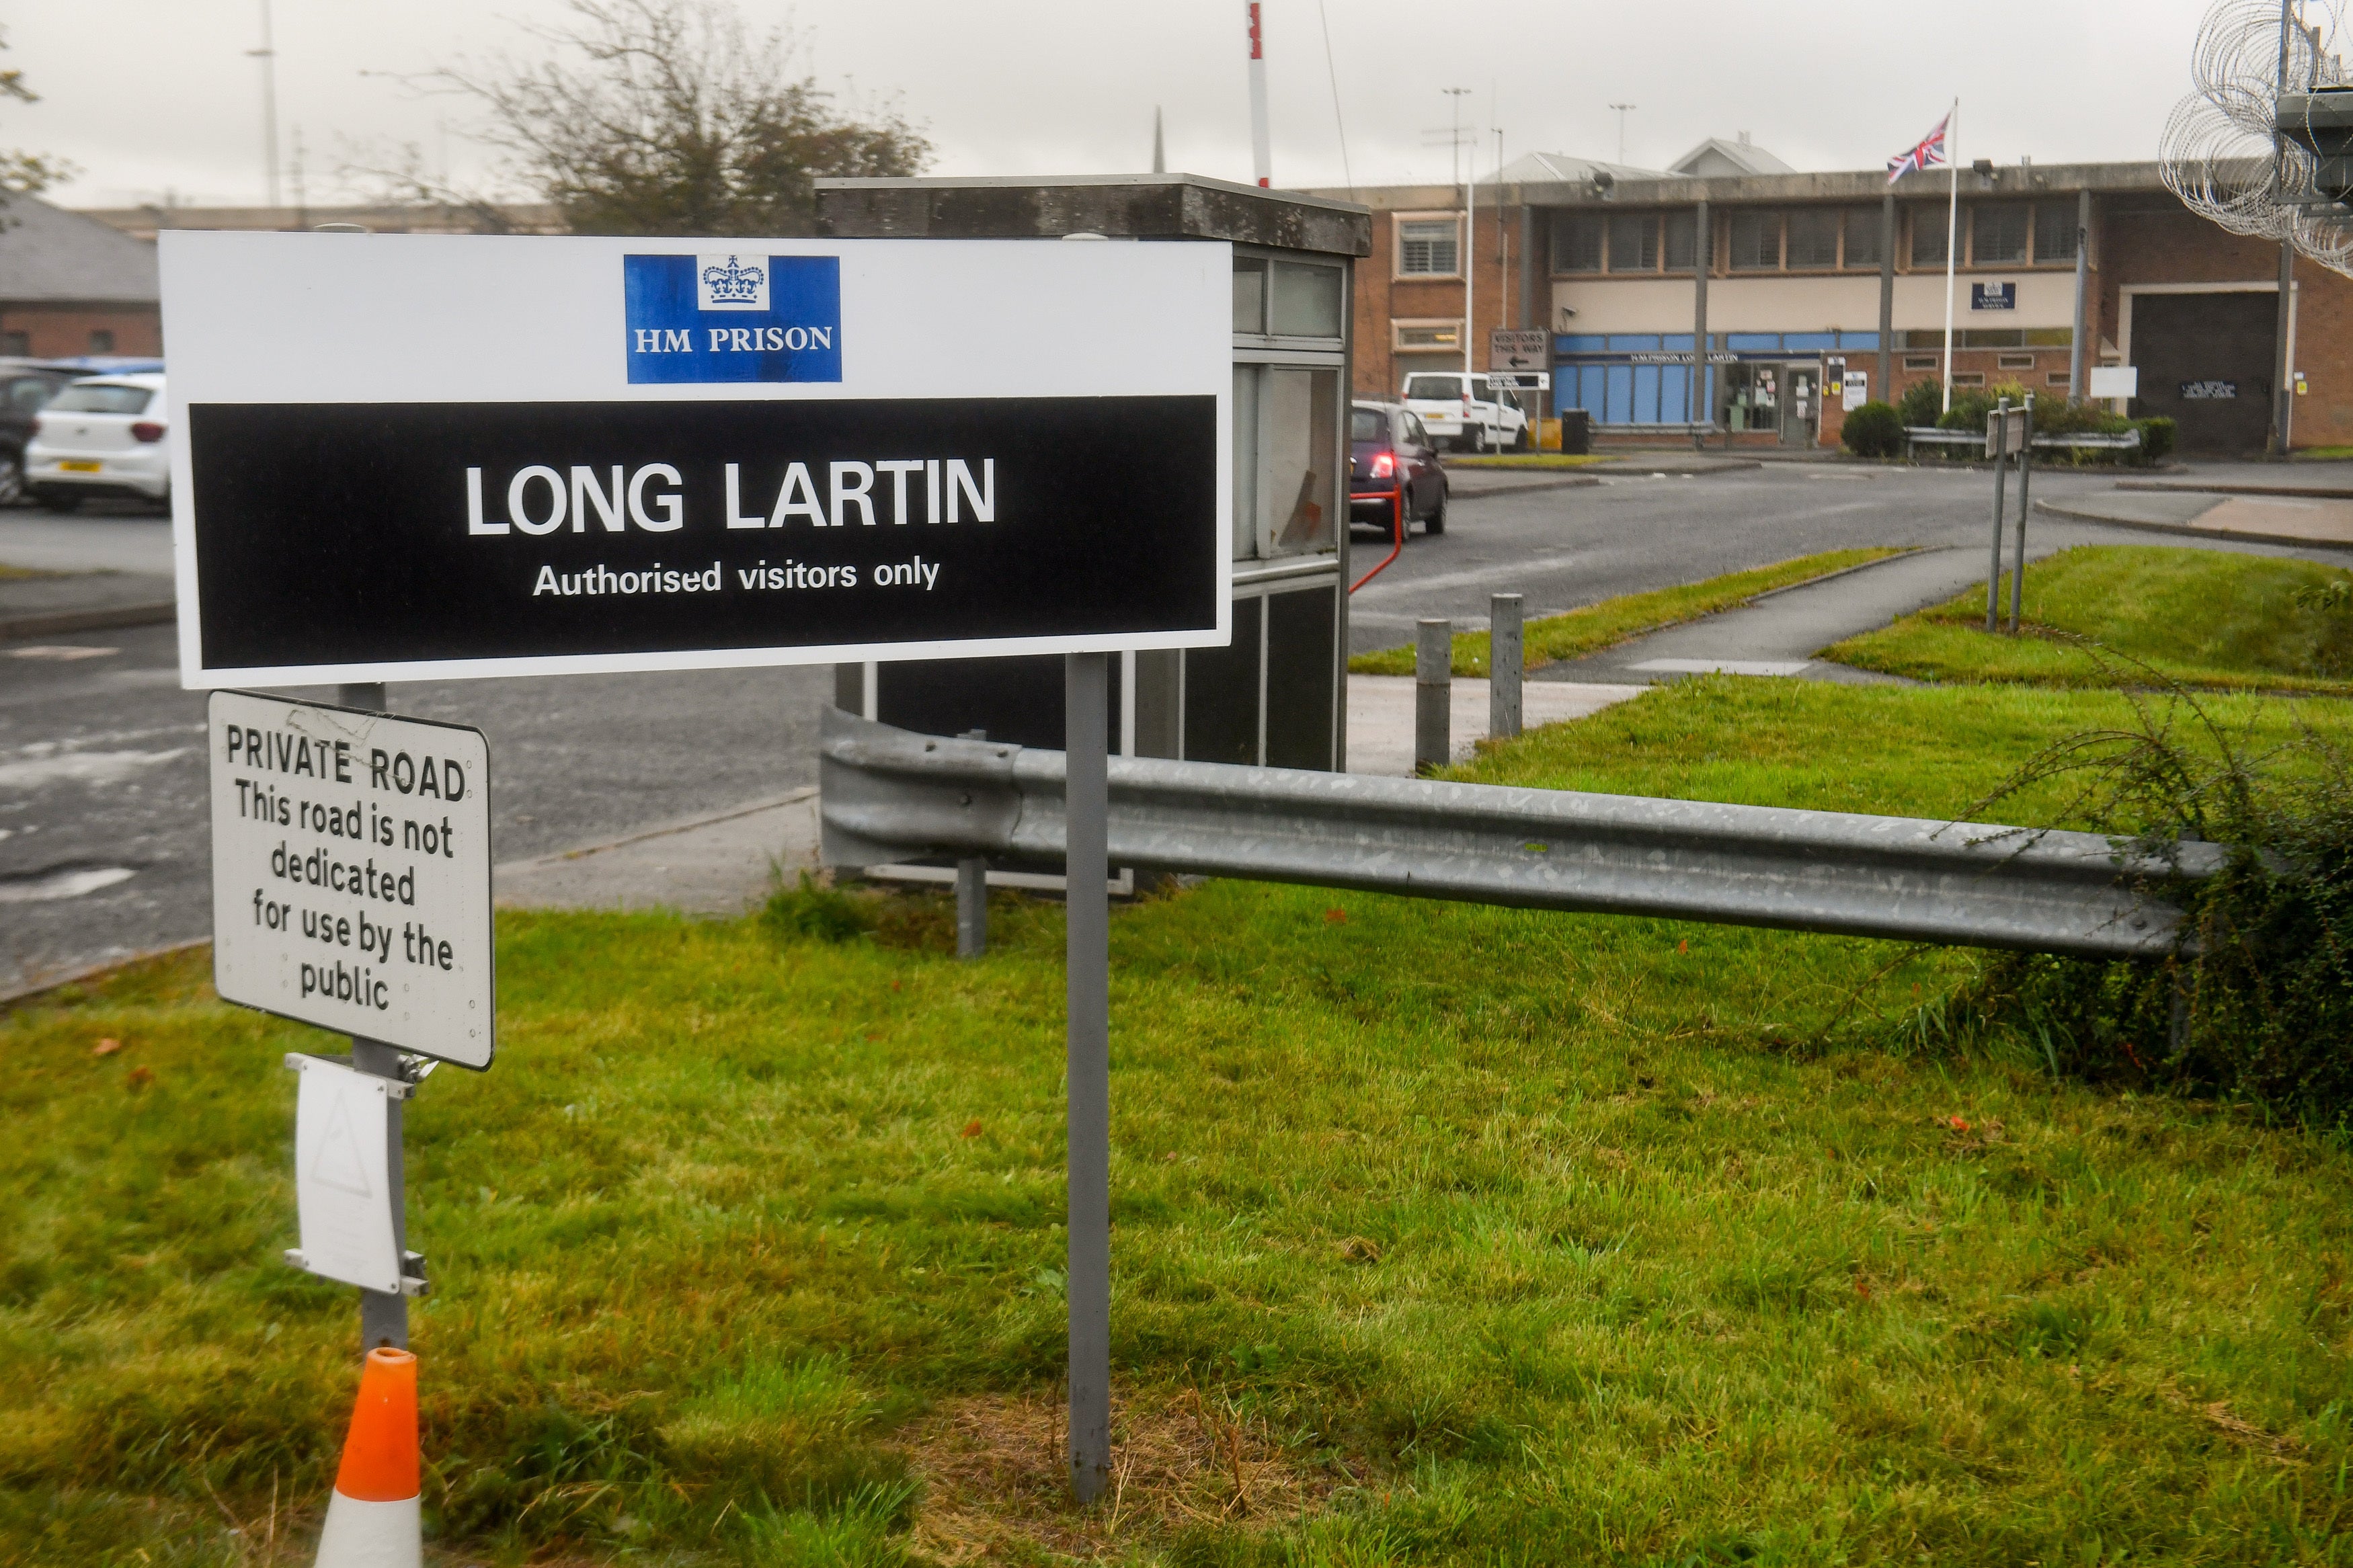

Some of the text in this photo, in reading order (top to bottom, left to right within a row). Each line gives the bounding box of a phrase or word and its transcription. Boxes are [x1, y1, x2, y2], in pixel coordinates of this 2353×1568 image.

[634, 326, 833, 353] HM PRISON
[1494, 334, 1543, 342] VISITORS
[1494, 344, 1543, 353] THIS WAY
[467, 458, 994, 536] LONG LARTIN
[532, 555, 940, 596] Authorised visitors only
[227, 724, 466, 802] PRIVATE ROAD
[235, 778, 453, 858] This road is not
[272, 841, 415, 906] dedicated
[253, 889, 453, 971] for use by the
[301, 960, 389, 1011] public
